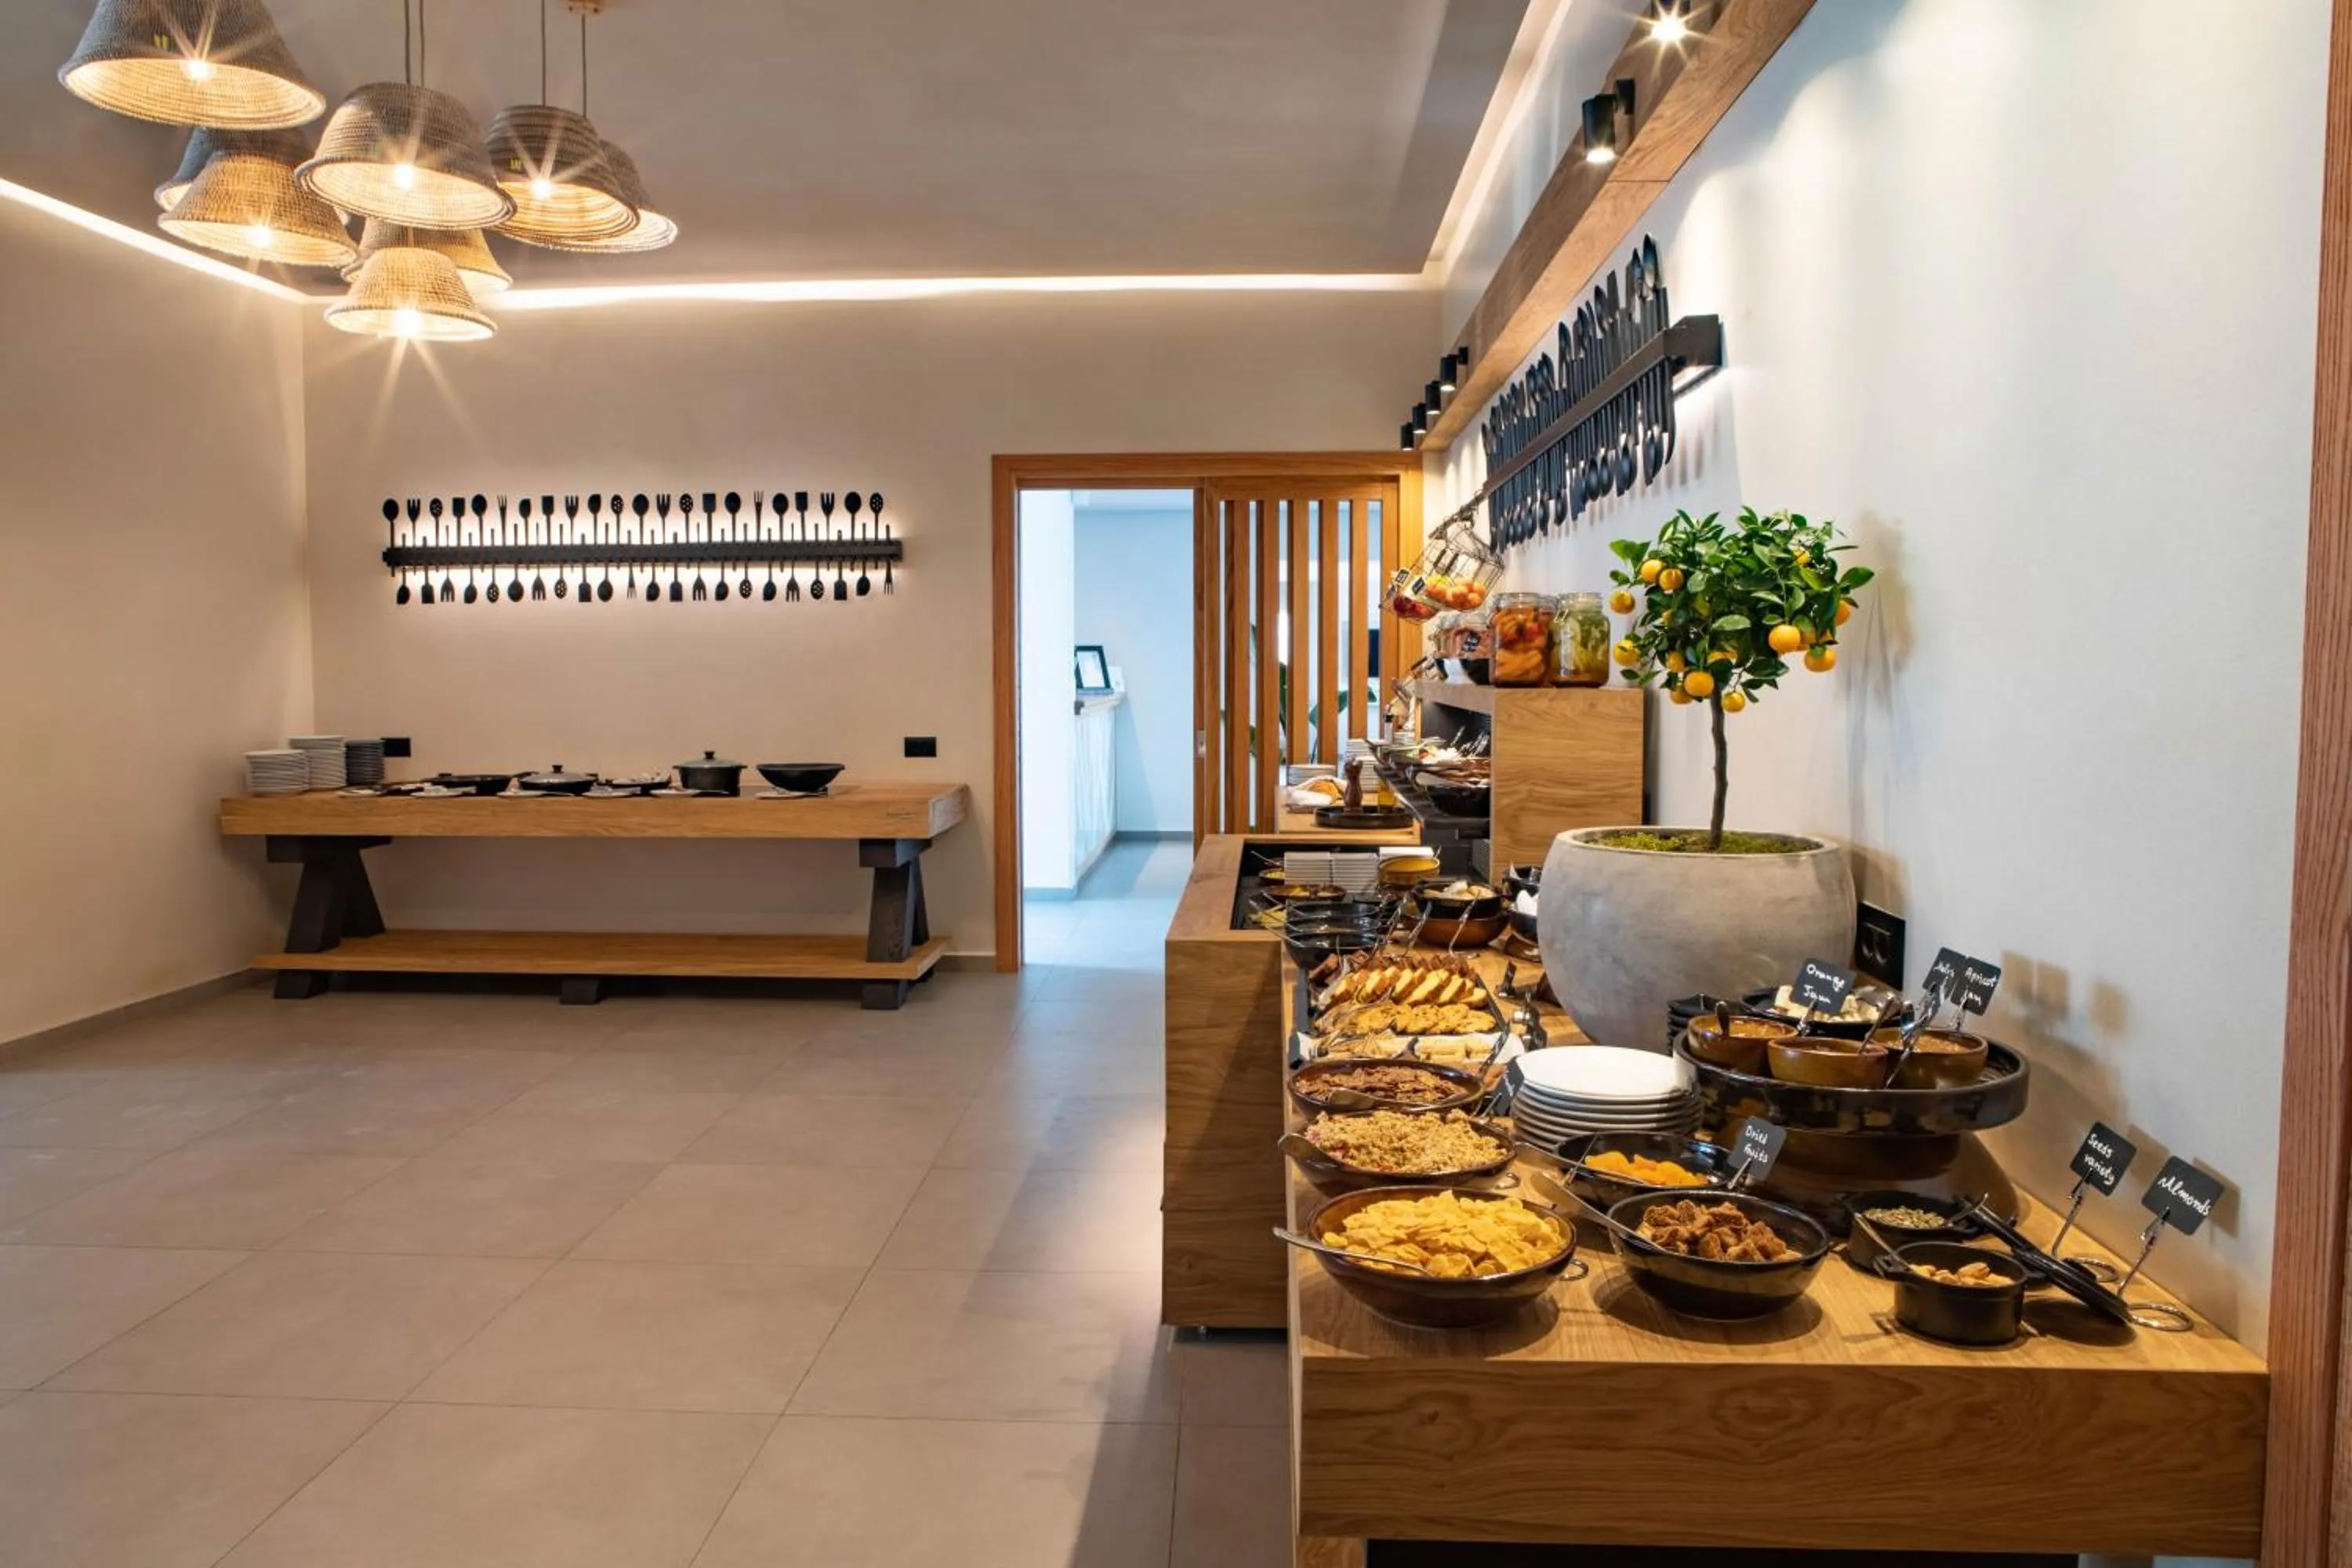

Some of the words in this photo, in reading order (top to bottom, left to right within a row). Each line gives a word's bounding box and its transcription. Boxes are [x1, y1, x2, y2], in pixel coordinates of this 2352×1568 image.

[1806, 964, 1845, 992] Orange
[1964, 967, 1997, 988] Apricot
[1803, 984, 1831, 1004] Jam
[1744, 1125, 1768, 1145] Dried
[2088, 1133, 2113, 1159] Seeds
[2084, 1153, 2114, 1185] variety
[2157, 1176, 2211, 1216] Almonds
